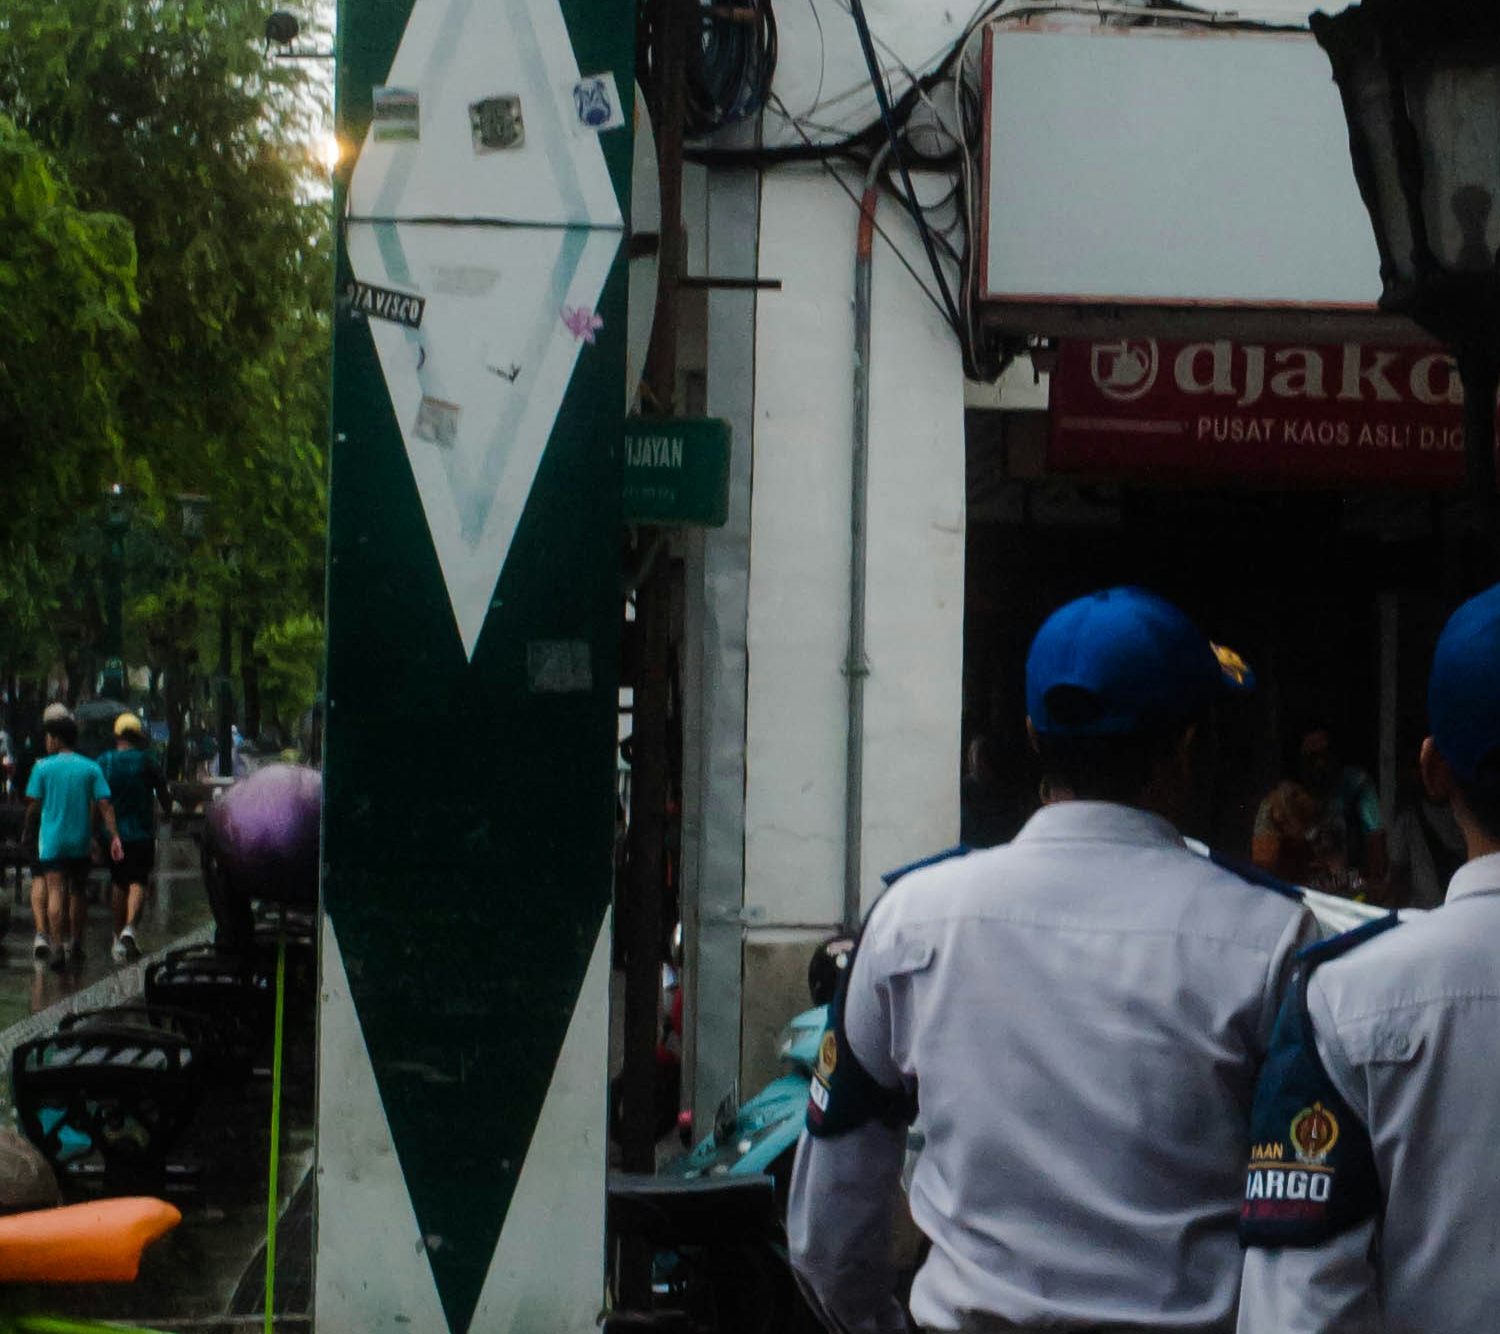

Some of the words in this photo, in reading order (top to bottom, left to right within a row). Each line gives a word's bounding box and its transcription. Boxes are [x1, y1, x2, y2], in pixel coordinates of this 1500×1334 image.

[625, 433, 684, 468] IJAYAN
[1196, 417, 1274, 444] PUSAT
[1283, 420, 1351, 446] KAOS
[1357, 423, 1412, 450] ASLI
